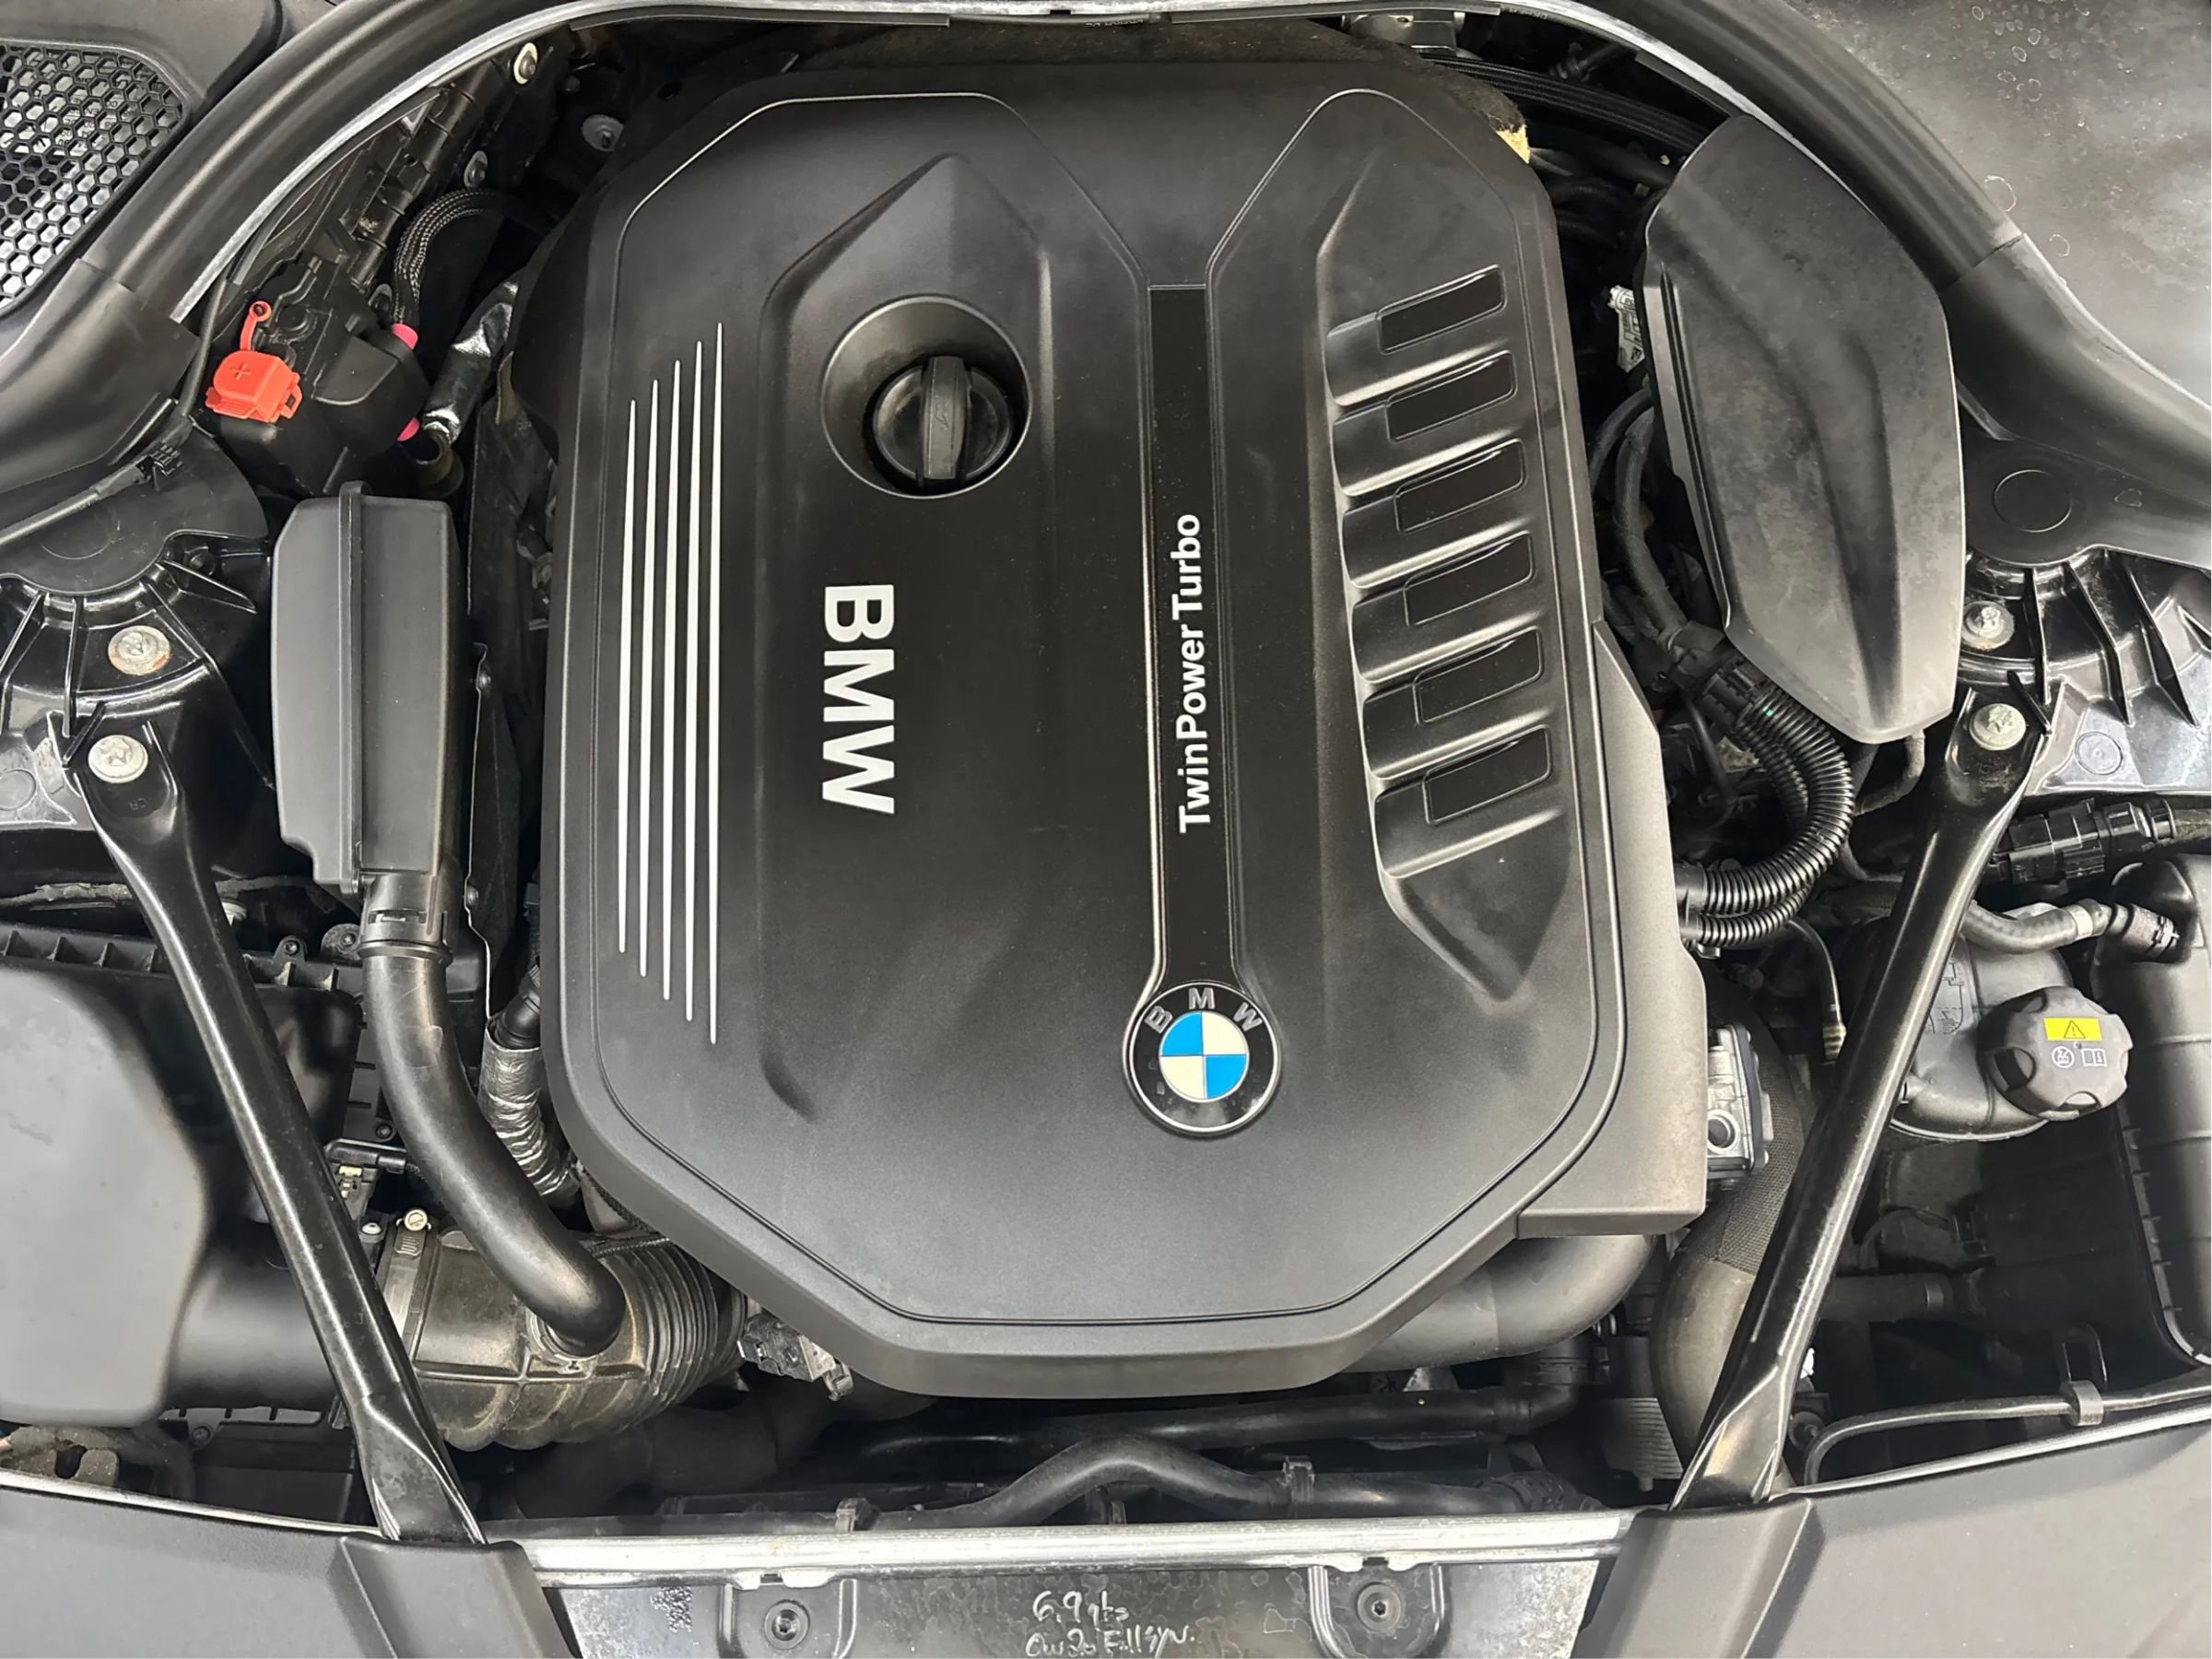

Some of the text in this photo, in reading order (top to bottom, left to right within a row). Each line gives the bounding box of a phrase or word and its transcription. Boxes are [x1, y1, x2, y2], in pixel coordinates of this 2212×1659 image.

[822, 583, 895, 815] BMW
[1170, 513, 1211, 834] TwinPower Turbo
[1144, 987, 1263, 1034] BMW
